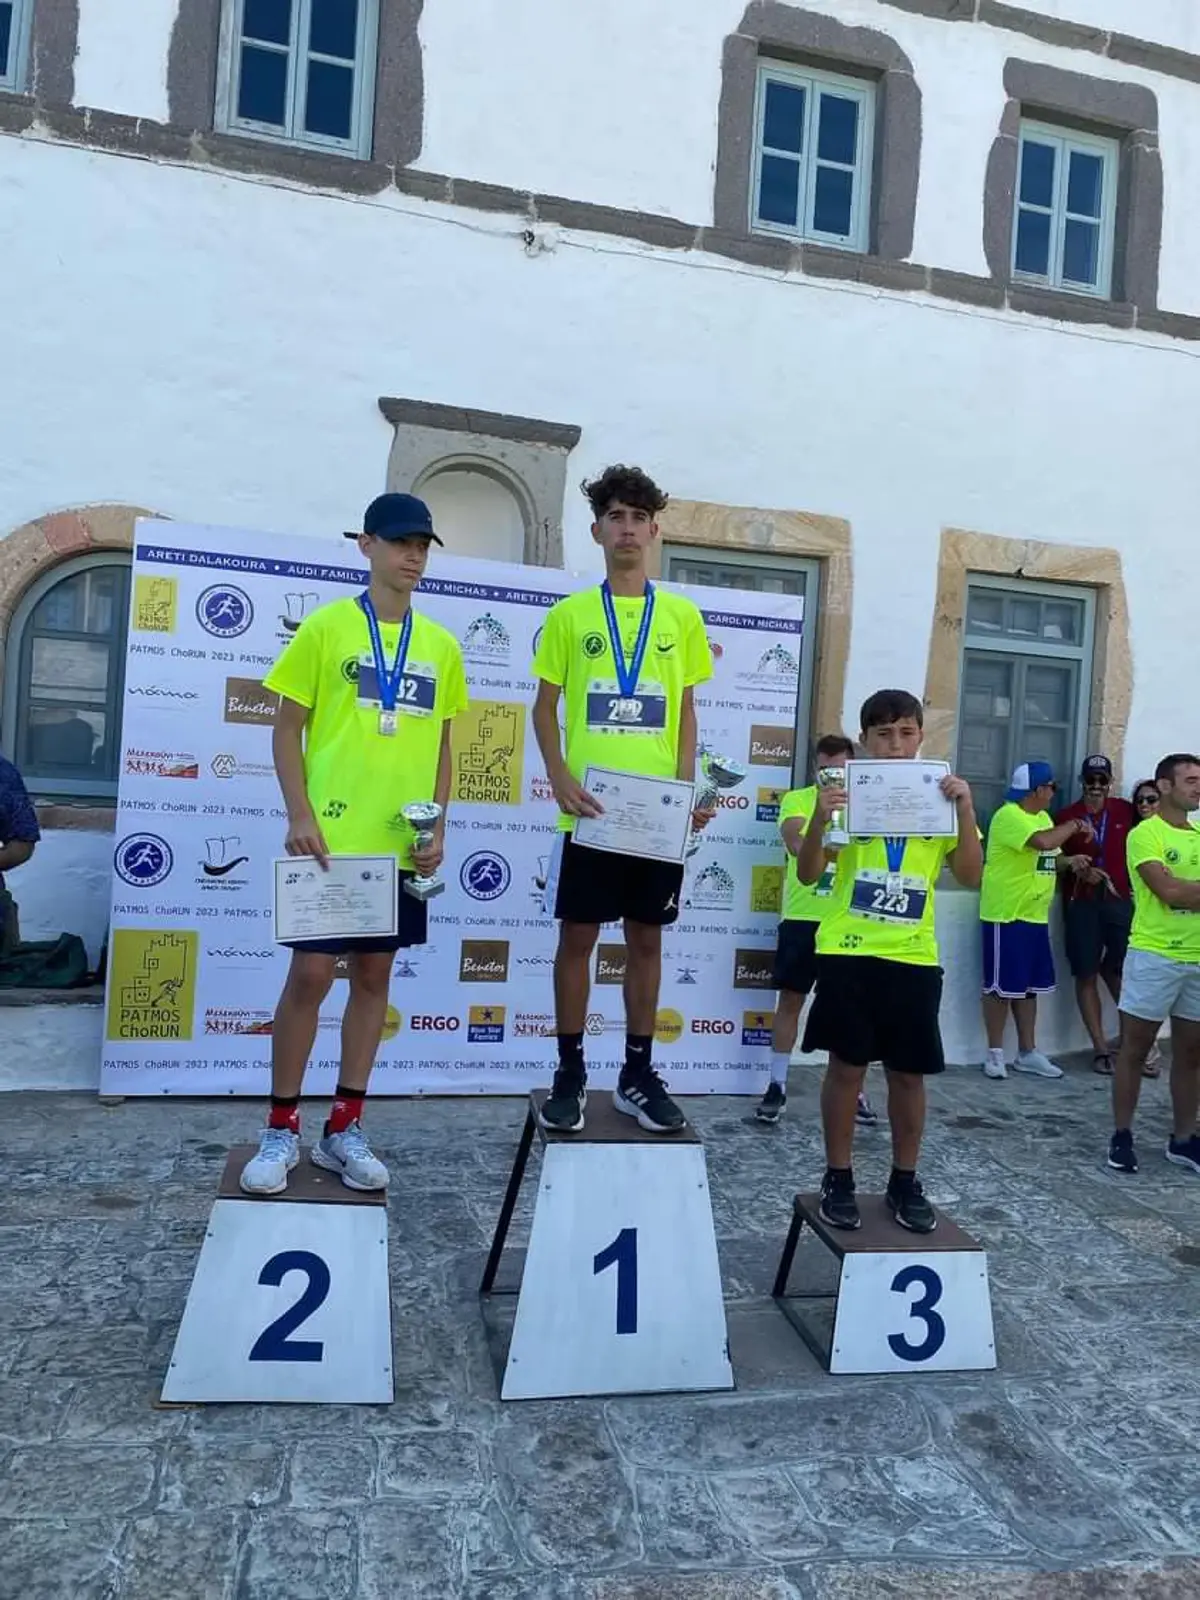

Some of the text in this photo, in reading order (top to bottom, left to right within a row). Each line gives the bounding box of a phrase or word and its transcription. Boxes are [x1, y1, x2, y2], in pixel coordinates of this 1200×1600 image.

[147, 549, 267, 571] ARETI DALAKOURA
[287, 565, 366, 582] AUDI FAMILY
[444, 583, 488, 597] MICHAS
[505, 592, 539, 604] ARETI
[708, 614, 796, 631] CAROLYN MICHAS
[130, 643, 165, 656] PATMOS
[211, 651, 235, 662] 2023
[228, 696, 276, 716] Benetos
[458, 773, 511, 788] PATMOS
[457, 787, 511, 803] ChoRUN
[712, 795, 749, 810] RGO
[120, 799, 156, 811] PATMOS
[202, 804, 225, 815] 2023
[871, 888, 910, 914] 223
[113, 904, 149, 914] PATMOS
[195, 907, 218, 917] 2023
[462, 957, 506, 973] Benetos
[121, 1008, 181, 1023] PATMOS
[410, 1015, 460, 1032] ERGO
[119, 1024, 180, 1038] ChoRUN
[691, 1019, 736, 1035] ERGO
[103, 1060, 140, 1069] PATMOS
[593, 1227, 638, 1335] 1
[248, 1249, 331, 1362] 2
[887, 1264, 946, 1362] 3
